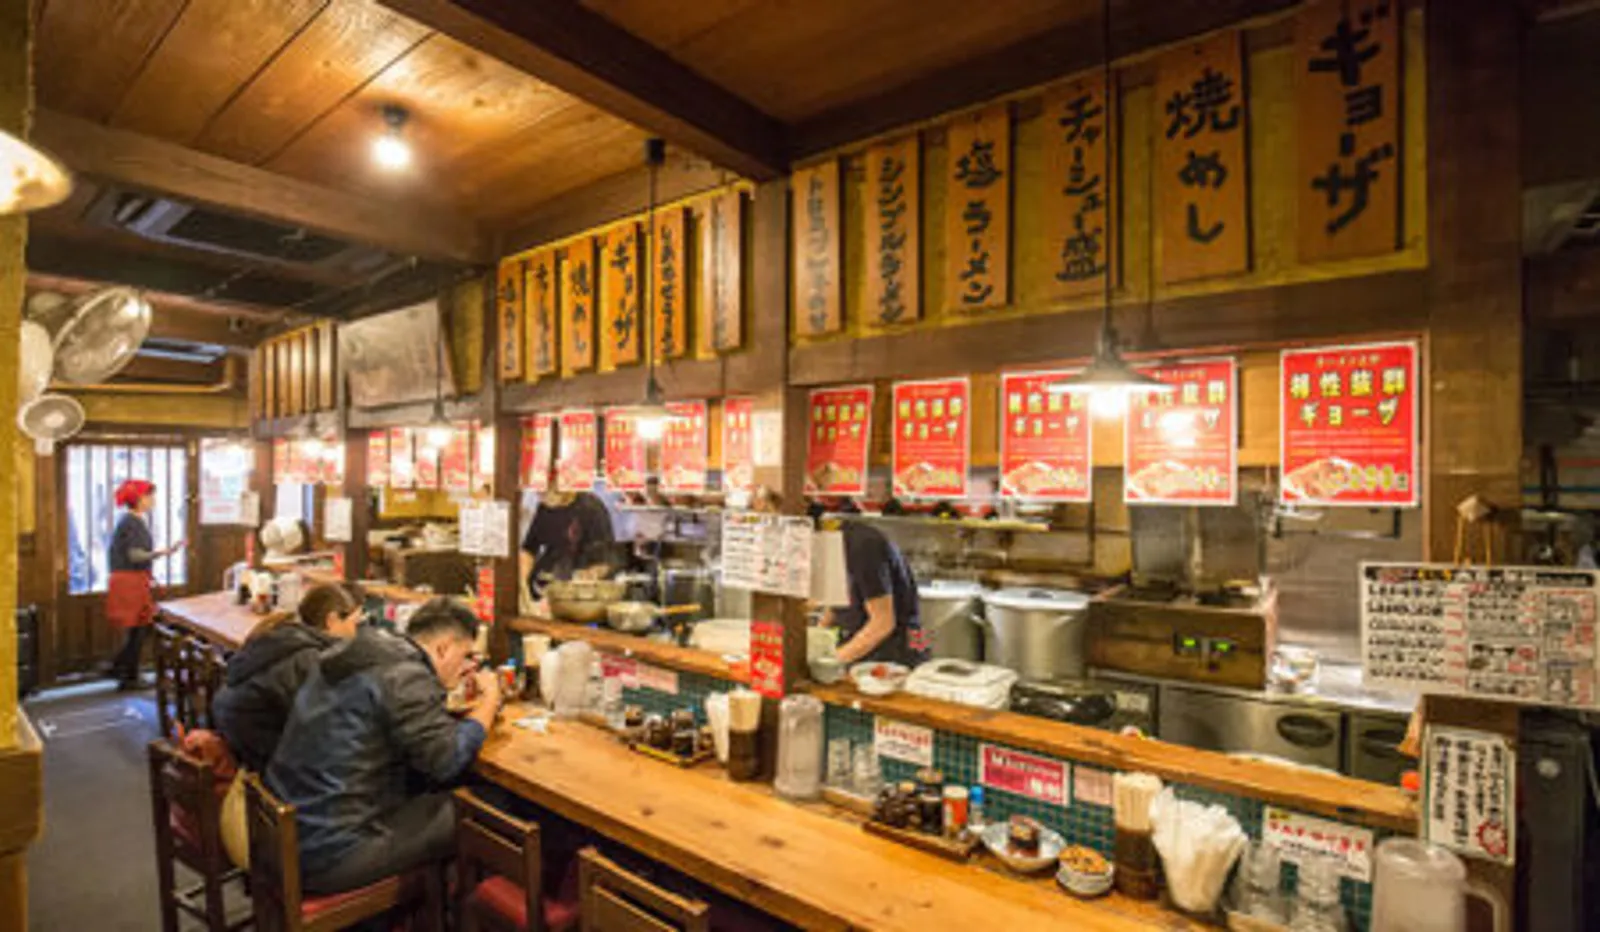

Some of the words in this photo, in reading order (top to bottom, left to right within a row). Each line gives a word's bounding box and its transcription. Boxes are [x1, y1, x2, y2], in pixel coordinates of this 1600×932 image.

[1055, 92, 1107, 283] チャーシュー盛
[1166, 66, 1242, 245] 焼めし
[1308, 2, 1394, 236] ギョーザ
[610, 232, 638, 350] ギョーザ
[954, 140, 1002, 304] 塩ラーメン
[1301, 397, 1399, 427] ギョーザ
